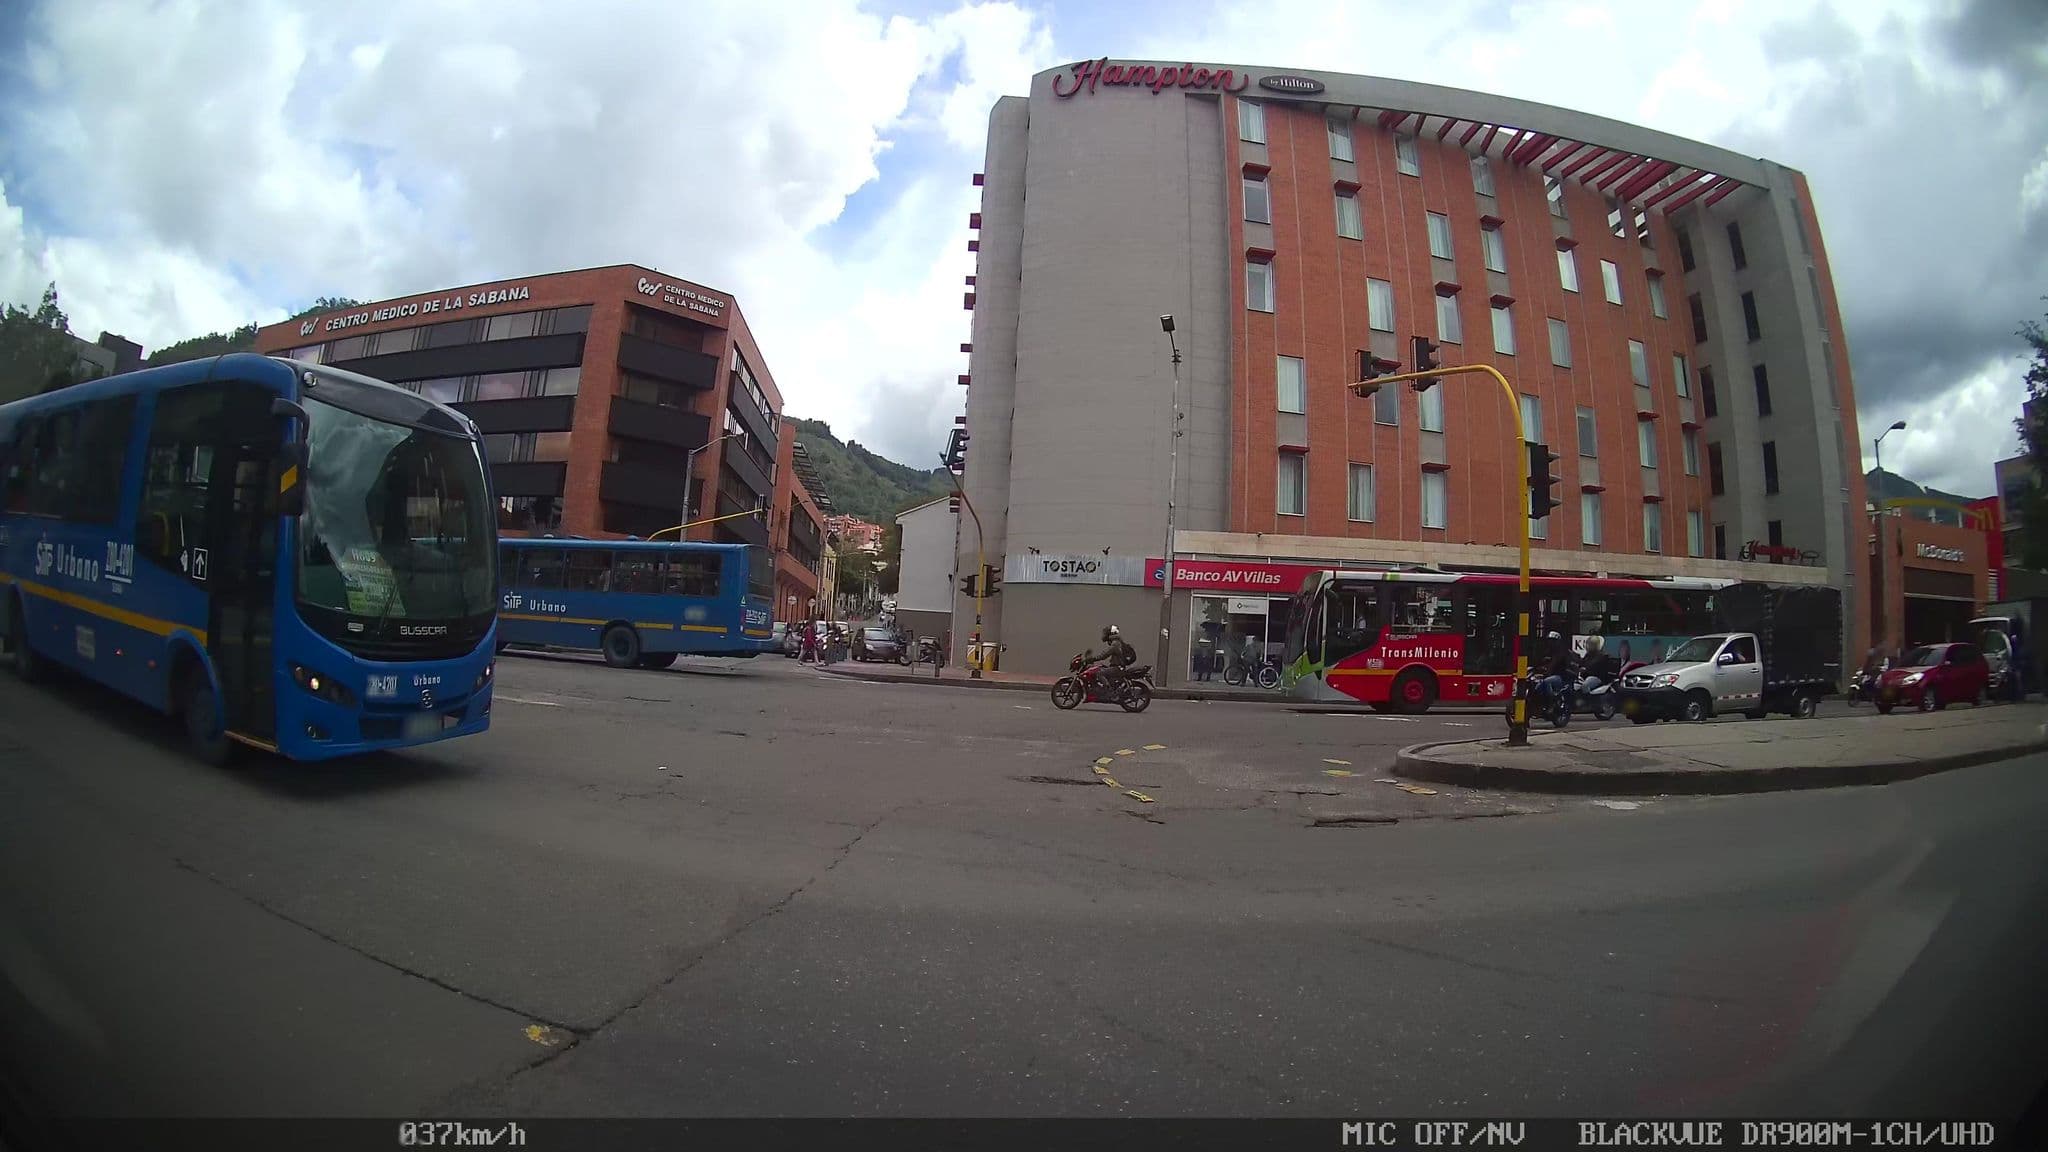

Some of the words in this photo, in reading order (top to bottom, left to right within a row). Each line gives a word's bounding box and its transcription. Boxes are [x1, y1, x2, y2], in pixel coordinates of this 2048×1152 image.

[1052, 57, 1249, 98] Hampton
[1279, 77, 1315, 89] Hilton
[665, 285, 696, 299] CENTRO
[697, 294, 725, 308] MEDICO
[325, 312, 369, 331] CENTRO
[371, 303, 418, 322] MEDICO
[422, 299, 440, 313] DE
[444, 296, 463, 310] LA
[468, 286, 530, 306] SABANA
[664, 295, 675, 304] DE
[676, 298, 687, 307] LA
[689, 302, 719, 317] SABANA
[57, 543, 99, 582] Urbano
[1176, 568, 1220, 582] Banco
[1222, 570, 1243, 582] AV
[1243, 571, 1281, 584] Villas
[530, 599, 567, 613] Urbano
[400, 626, 447, 636] BUSSCAR
[1381, 647, 1459, 659] TransMilenio
[413, 676, 441, 687] Urbano
